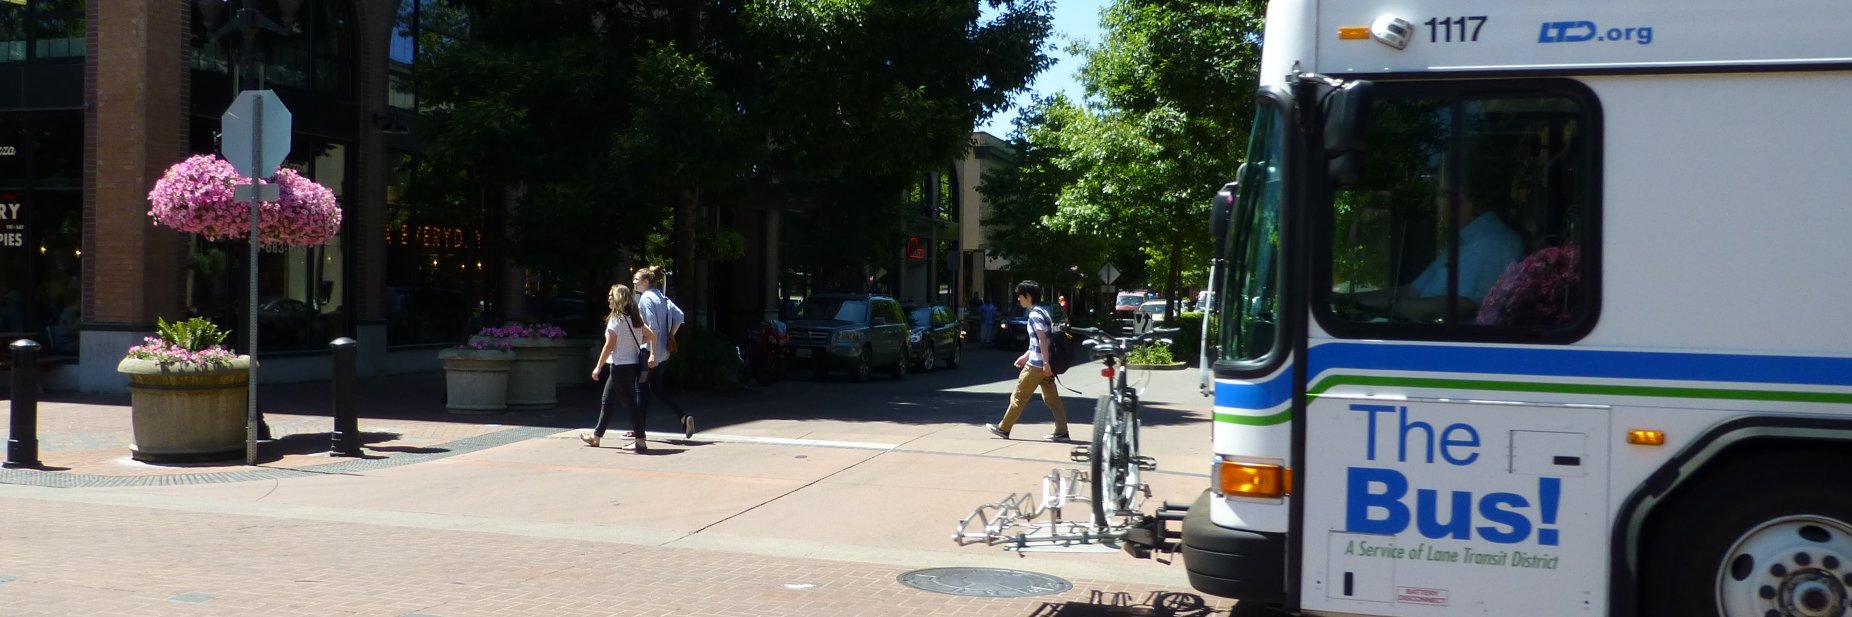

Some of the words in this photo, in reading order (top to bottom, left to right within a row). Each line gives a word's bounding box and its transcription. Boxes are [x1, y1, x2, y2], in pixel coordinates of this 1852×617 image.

[1424, 16, 1488, 43] 1117
[1349, 403, 1481, 466] The
[1346, 466, 1562, 546] Bus!
[1344, 540, 1354, 556] A
[1359, 541, 1405, 560] Service
[1409, 543, 1424, 561] of
[1427, 545, 1459, 564] Lane
[1463, 547, 1508, 566] Transit
[1511, 551, 1560, 570] District
[1398, 594, 1447, 604] DISCONNECT
[1406, 588, 1439, 596] BATTERY
